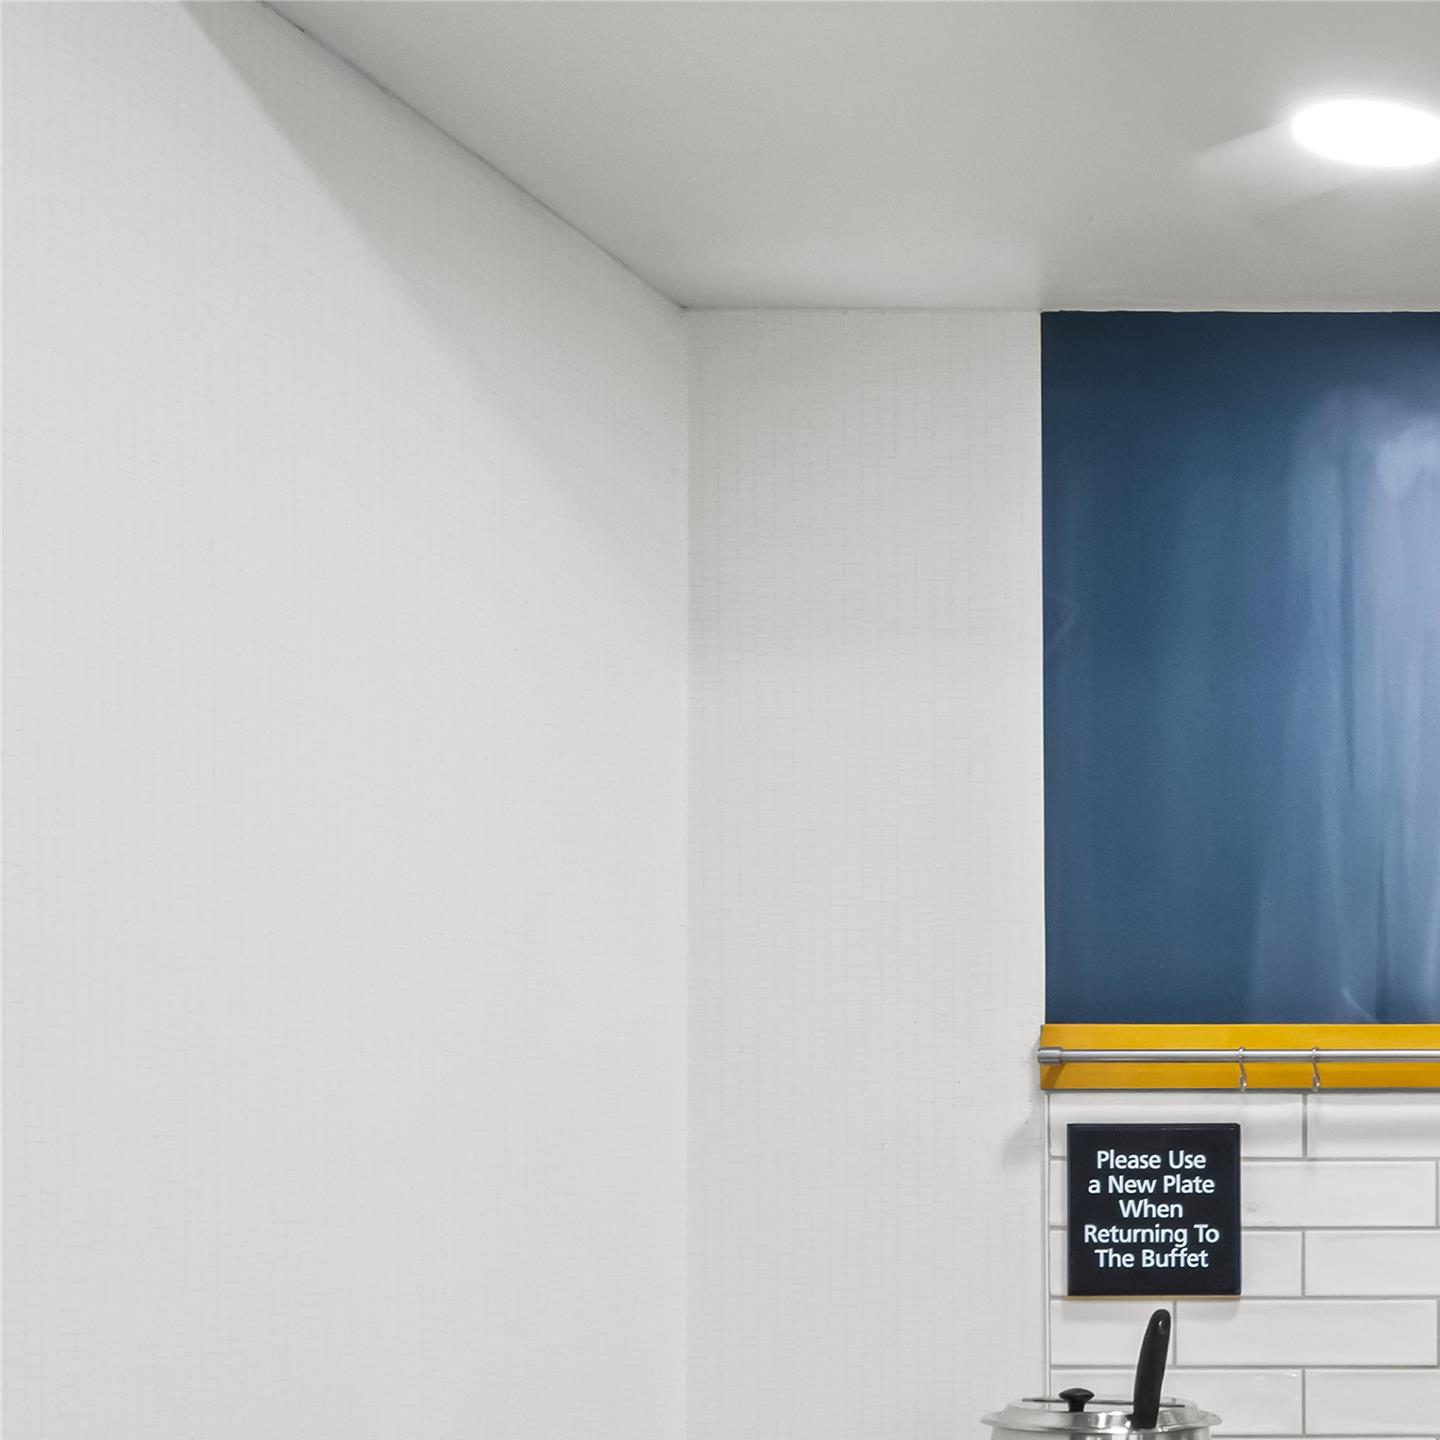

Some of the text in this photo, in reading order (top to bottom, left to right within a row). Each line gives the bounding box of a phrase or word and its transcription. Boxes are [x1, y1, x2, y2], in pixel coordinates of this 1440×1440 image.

[1097, 1149, 1207, 1169] Please Use
[1088, 1174, 1215, 1194] a New Plate
[1119, 1199, 1184, 1218] When
[1084, 1223, 1220, 1248] Returning To
[1094, 1248, 1209, 1268] The Buffet
